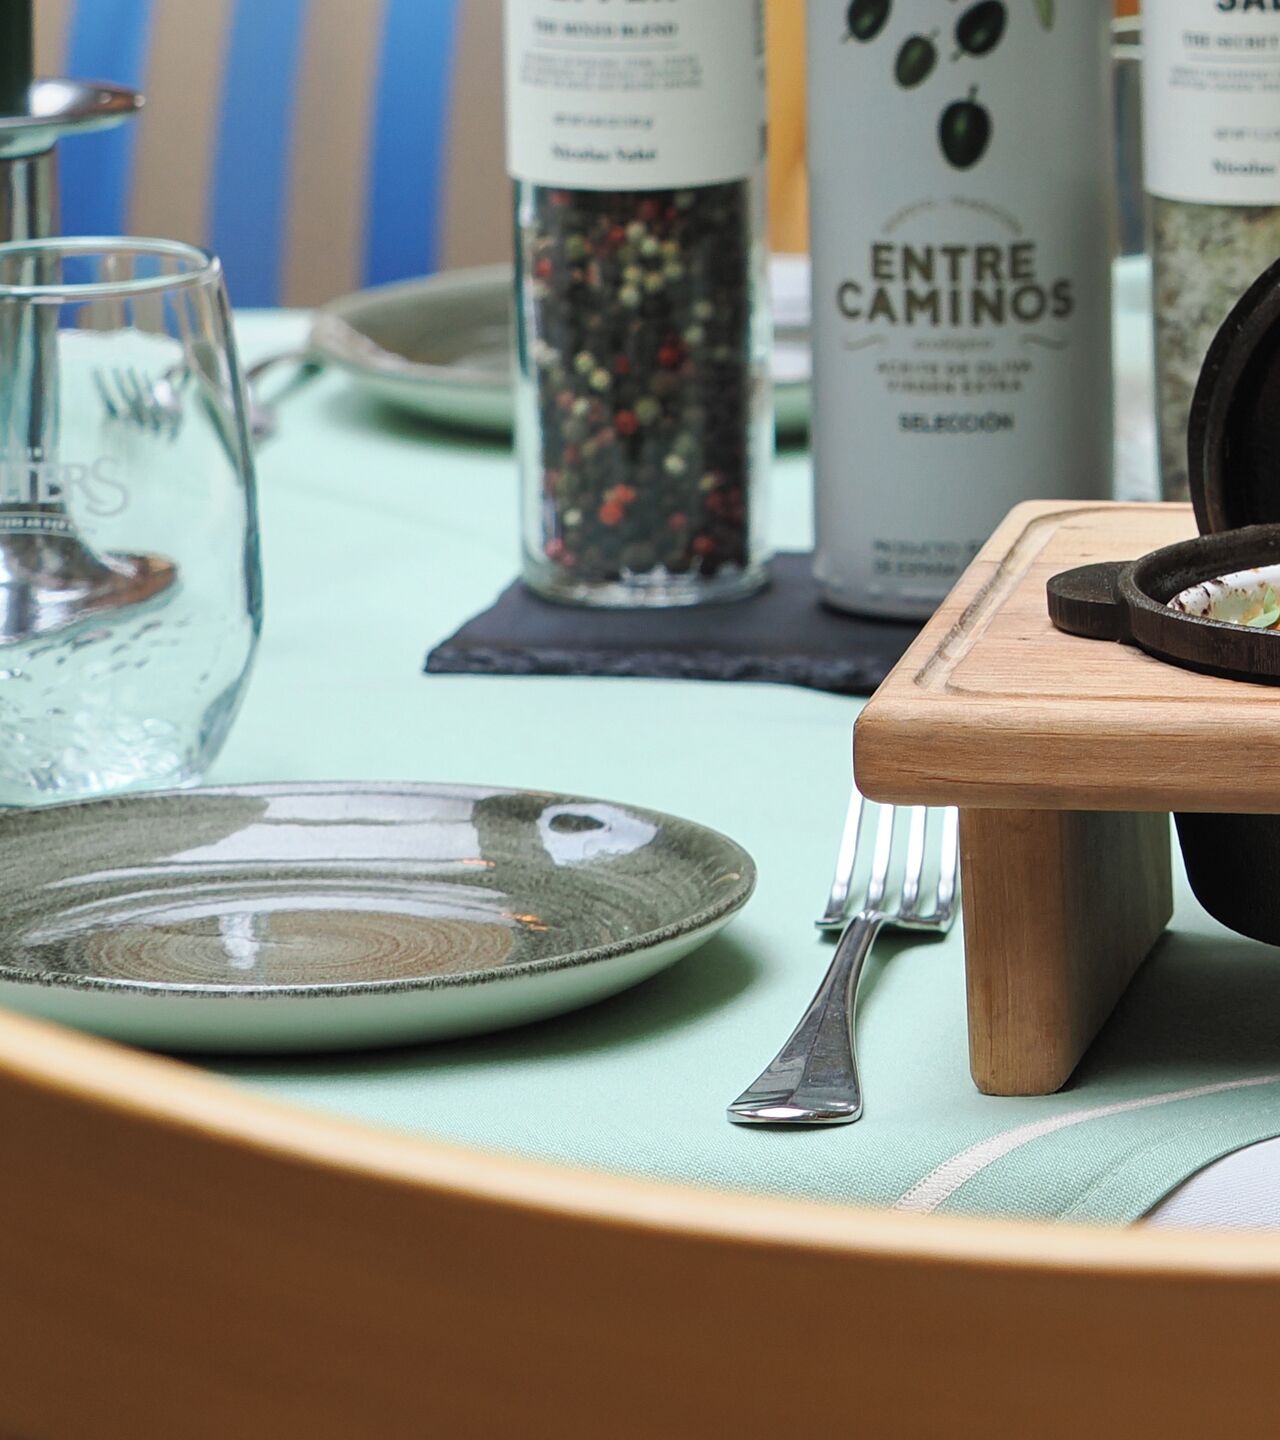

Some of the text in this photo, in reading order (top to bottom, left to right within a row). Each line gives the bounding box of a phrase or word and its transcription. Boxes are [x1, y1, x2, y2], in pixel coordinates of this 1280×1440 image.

[872, 244, 1036, 281] ENTRE
[838, 281, 1075, 327] CAMINOS
[900, 412, 1013, 431] SELECCIÓN
